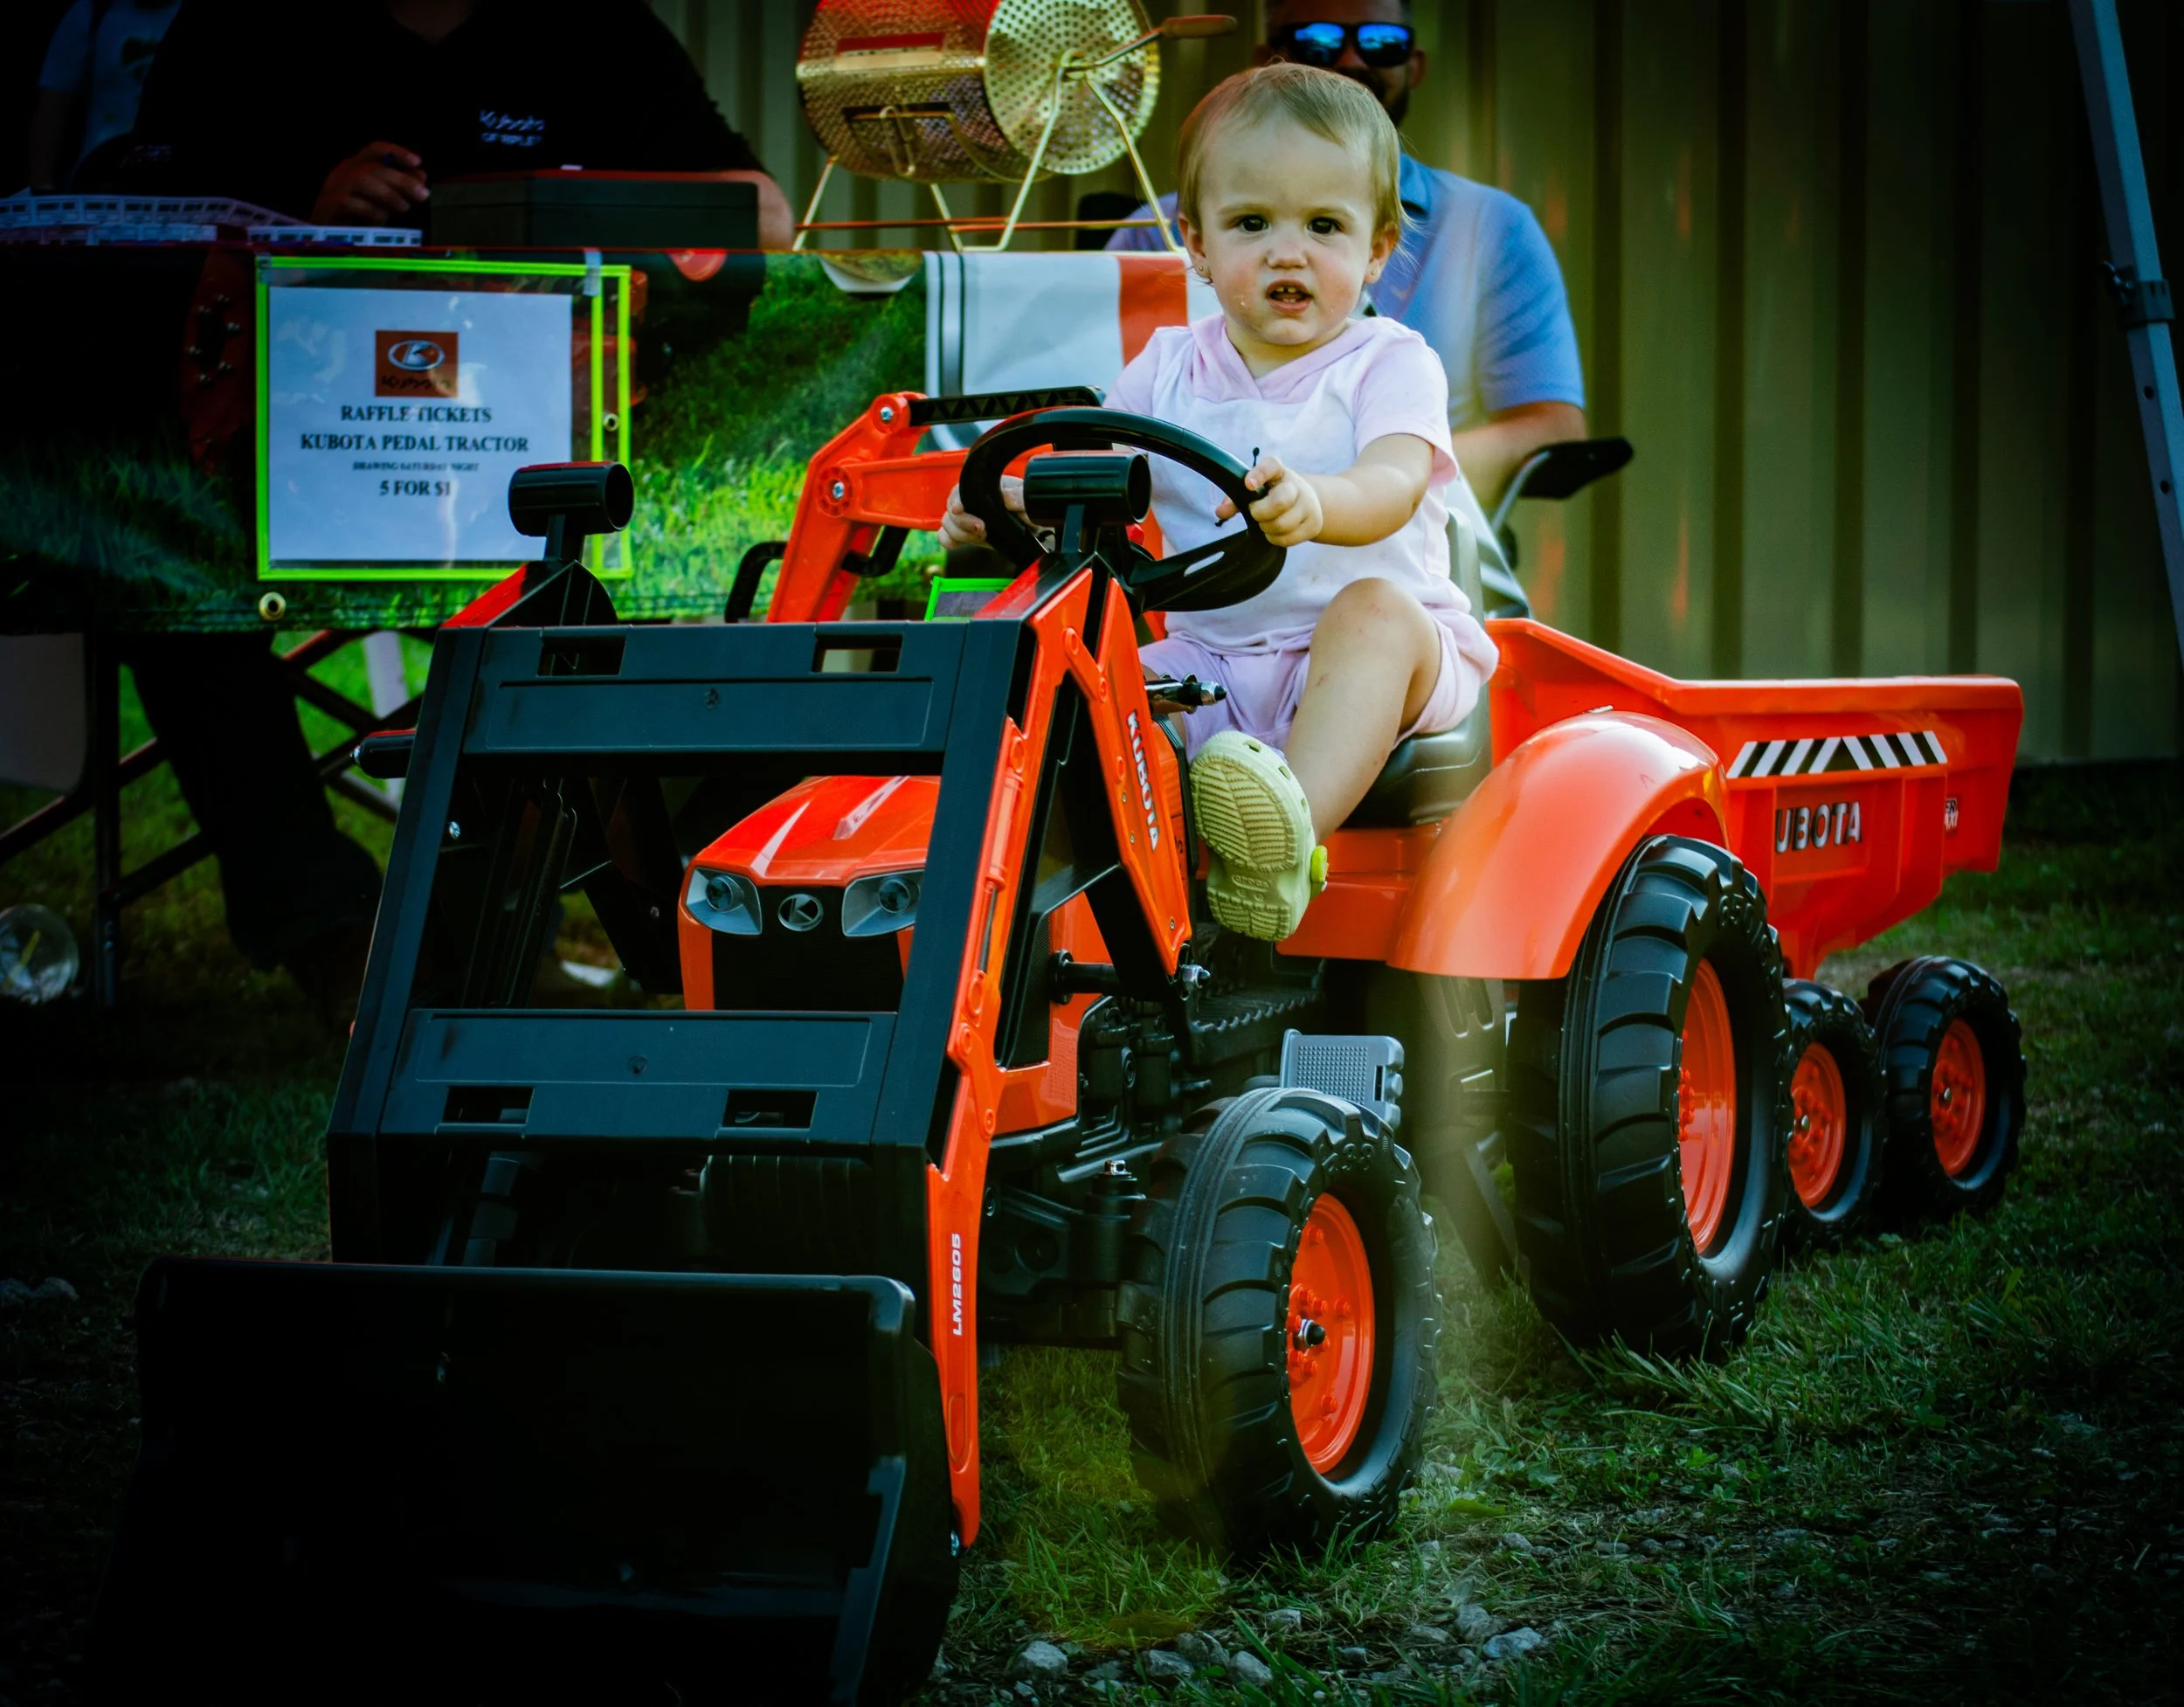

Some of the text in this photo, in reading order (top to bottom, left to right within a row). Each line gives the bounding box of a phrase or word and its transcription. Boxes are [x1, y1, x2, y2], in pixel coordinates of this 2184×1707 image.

[341, 405, 492, 423] RAFFLE TICKETS
[301, 434, 529, 453] KUBOTA PEDAL TRACTOR
[379, 480, 390, 495] 5
[393, 480, 430, 496] FOR
[1126, 708, 1159, 852] KUBOTA
[1775, 801, 1863, 854] UBOTA
[951, 1233, 963, 1337] LM2605
